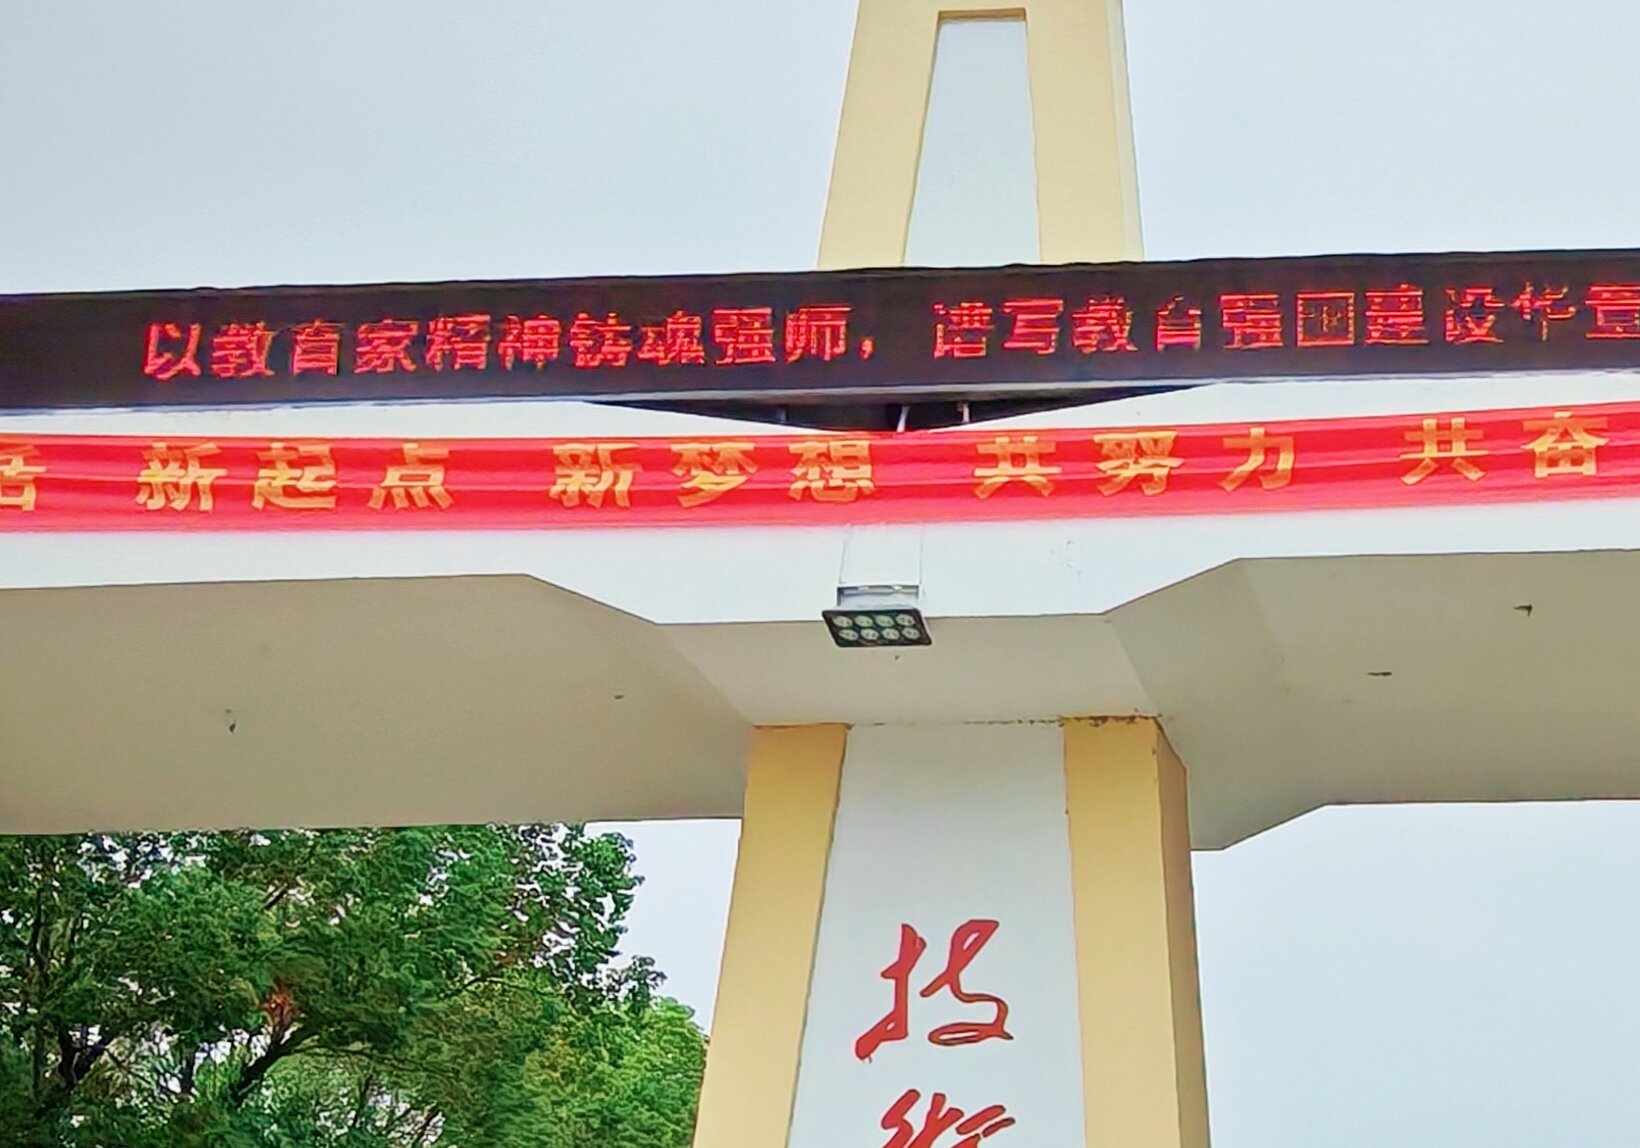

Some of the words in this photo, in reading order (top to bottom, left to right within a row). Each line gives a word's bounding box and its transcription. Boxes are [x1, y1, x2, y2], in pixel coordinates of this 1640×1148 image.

[136, 441, 455, 512] 新起点
[550, 440, 880, 510] 新梦想
[973, 426, 1297, 500] 共努力
